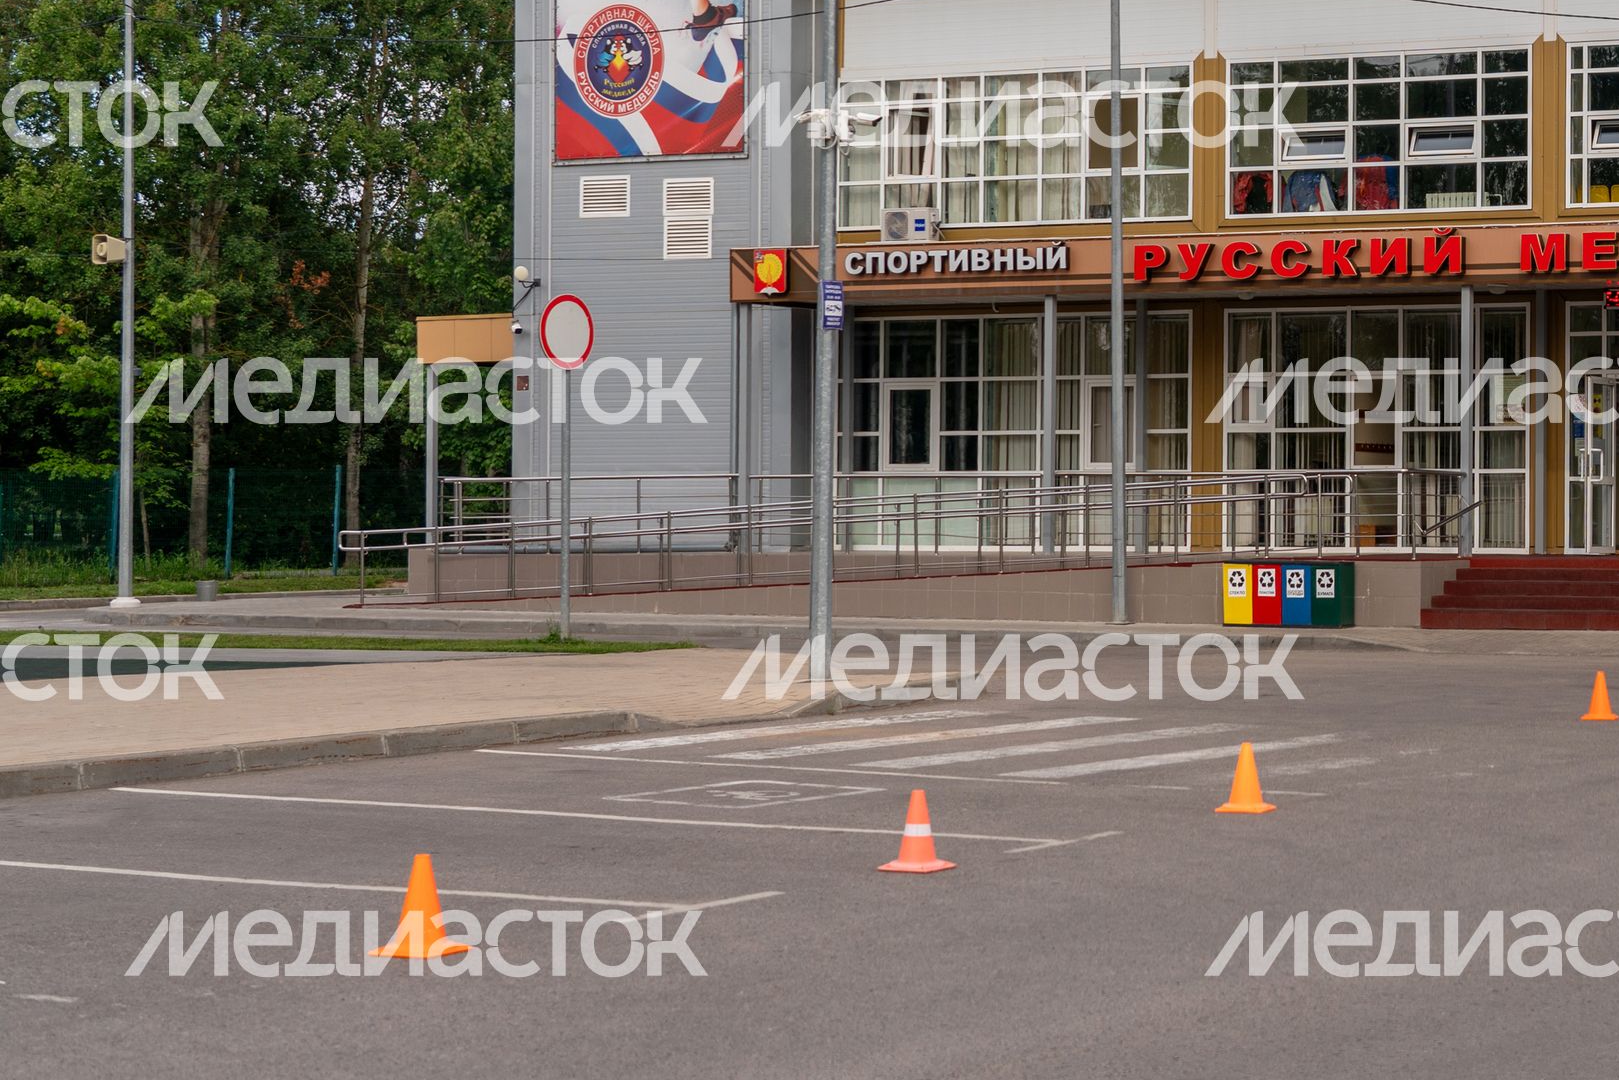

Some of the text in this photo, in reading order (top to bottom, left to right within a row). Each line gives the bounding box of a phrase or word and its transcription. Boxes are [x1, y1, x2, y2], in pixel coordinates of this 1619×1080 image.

[577, 8, 661, 58] СПОРТИВНАЯ ШКОЛА
[591, 23, 628, 49] СПОРТИВНАЯ
[577, 71, 660, 113] РУССКИЙ МЕДВЕДЬ
[845, 241, 1068, 275] СПОРТИВНЫЙ
[1133, 227, 1466, 282] РУССКИЙ
